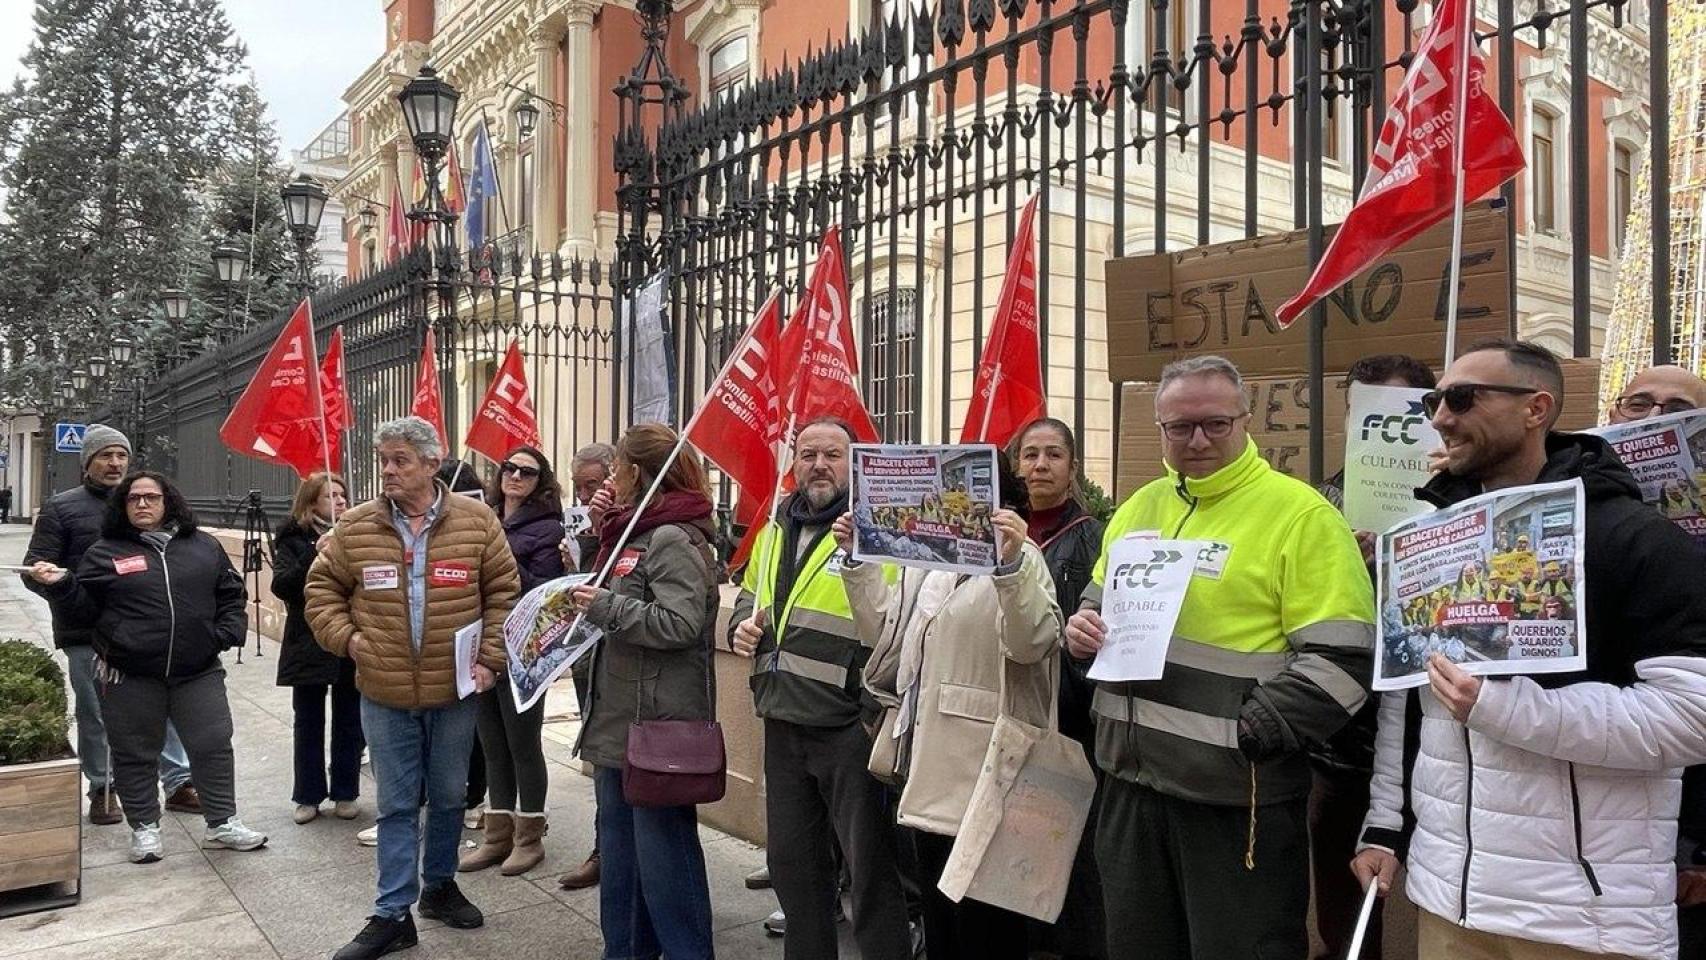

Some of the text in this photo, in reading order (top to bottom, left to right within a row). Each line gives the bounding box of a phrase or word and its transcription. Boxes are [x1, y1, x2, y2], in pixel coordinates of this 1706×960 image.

[1147, 278, 1277, 351] ESTA
[1361, 414, 1424, 445] FCC
[1622, 434, 1665, 451] QUIERE
[1635, 444, 1679, 461] CALIDAD
[1642, 461, 1678, 472] DIGNOS
[1401, 515, 1477, 548] ALBACETE QUIERE
[1406, 539, 1438, 557] SERVICIO
[1438, 535, 1450, 546] DE
[1451, 525, 1486, 542] CALIDAD
[1453, 542, 1479, 554] DIGNOS
[1197, 548, 1218, 561] CC
[435, 567, 468, 580] CCOO
[1113, 563, 1165, 590] FCC
[1113, 601, 1168, 614] CULPABLE
[1447, 604, 1499, 618] HUELGA
[540, 618, 569, 645] HUELGA
[1518, 637, 1563, 647] SALARIOS
